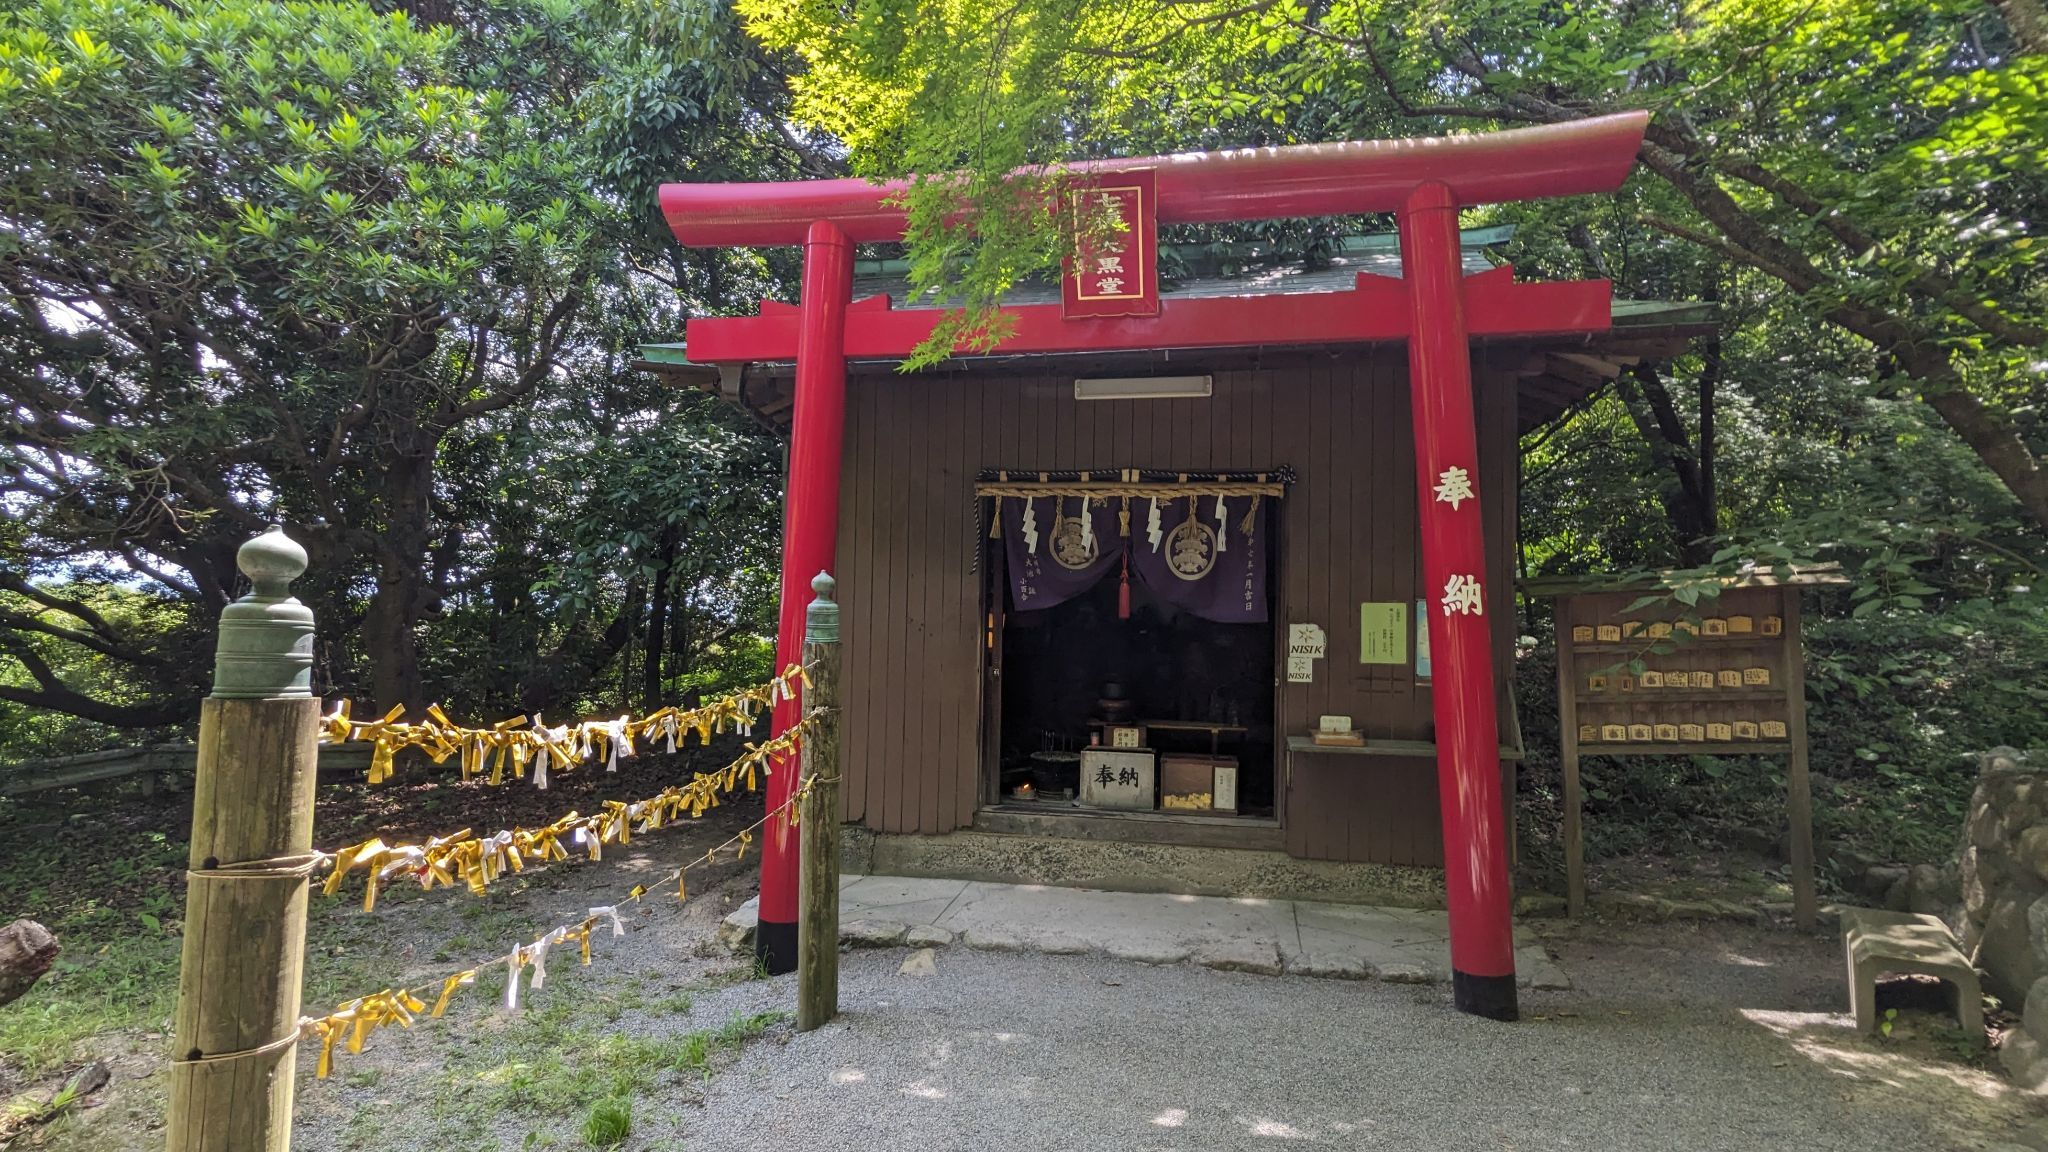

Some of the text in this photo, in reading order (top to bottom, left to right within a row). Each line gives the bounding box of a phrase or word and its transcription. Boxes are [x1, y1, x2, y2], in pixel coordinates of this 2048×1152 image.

[1433, 466, 1483, 616] 奉納
[1291, 645, 1322, 654] NISIK
[1094, 763, 1139, 789] 奉納
